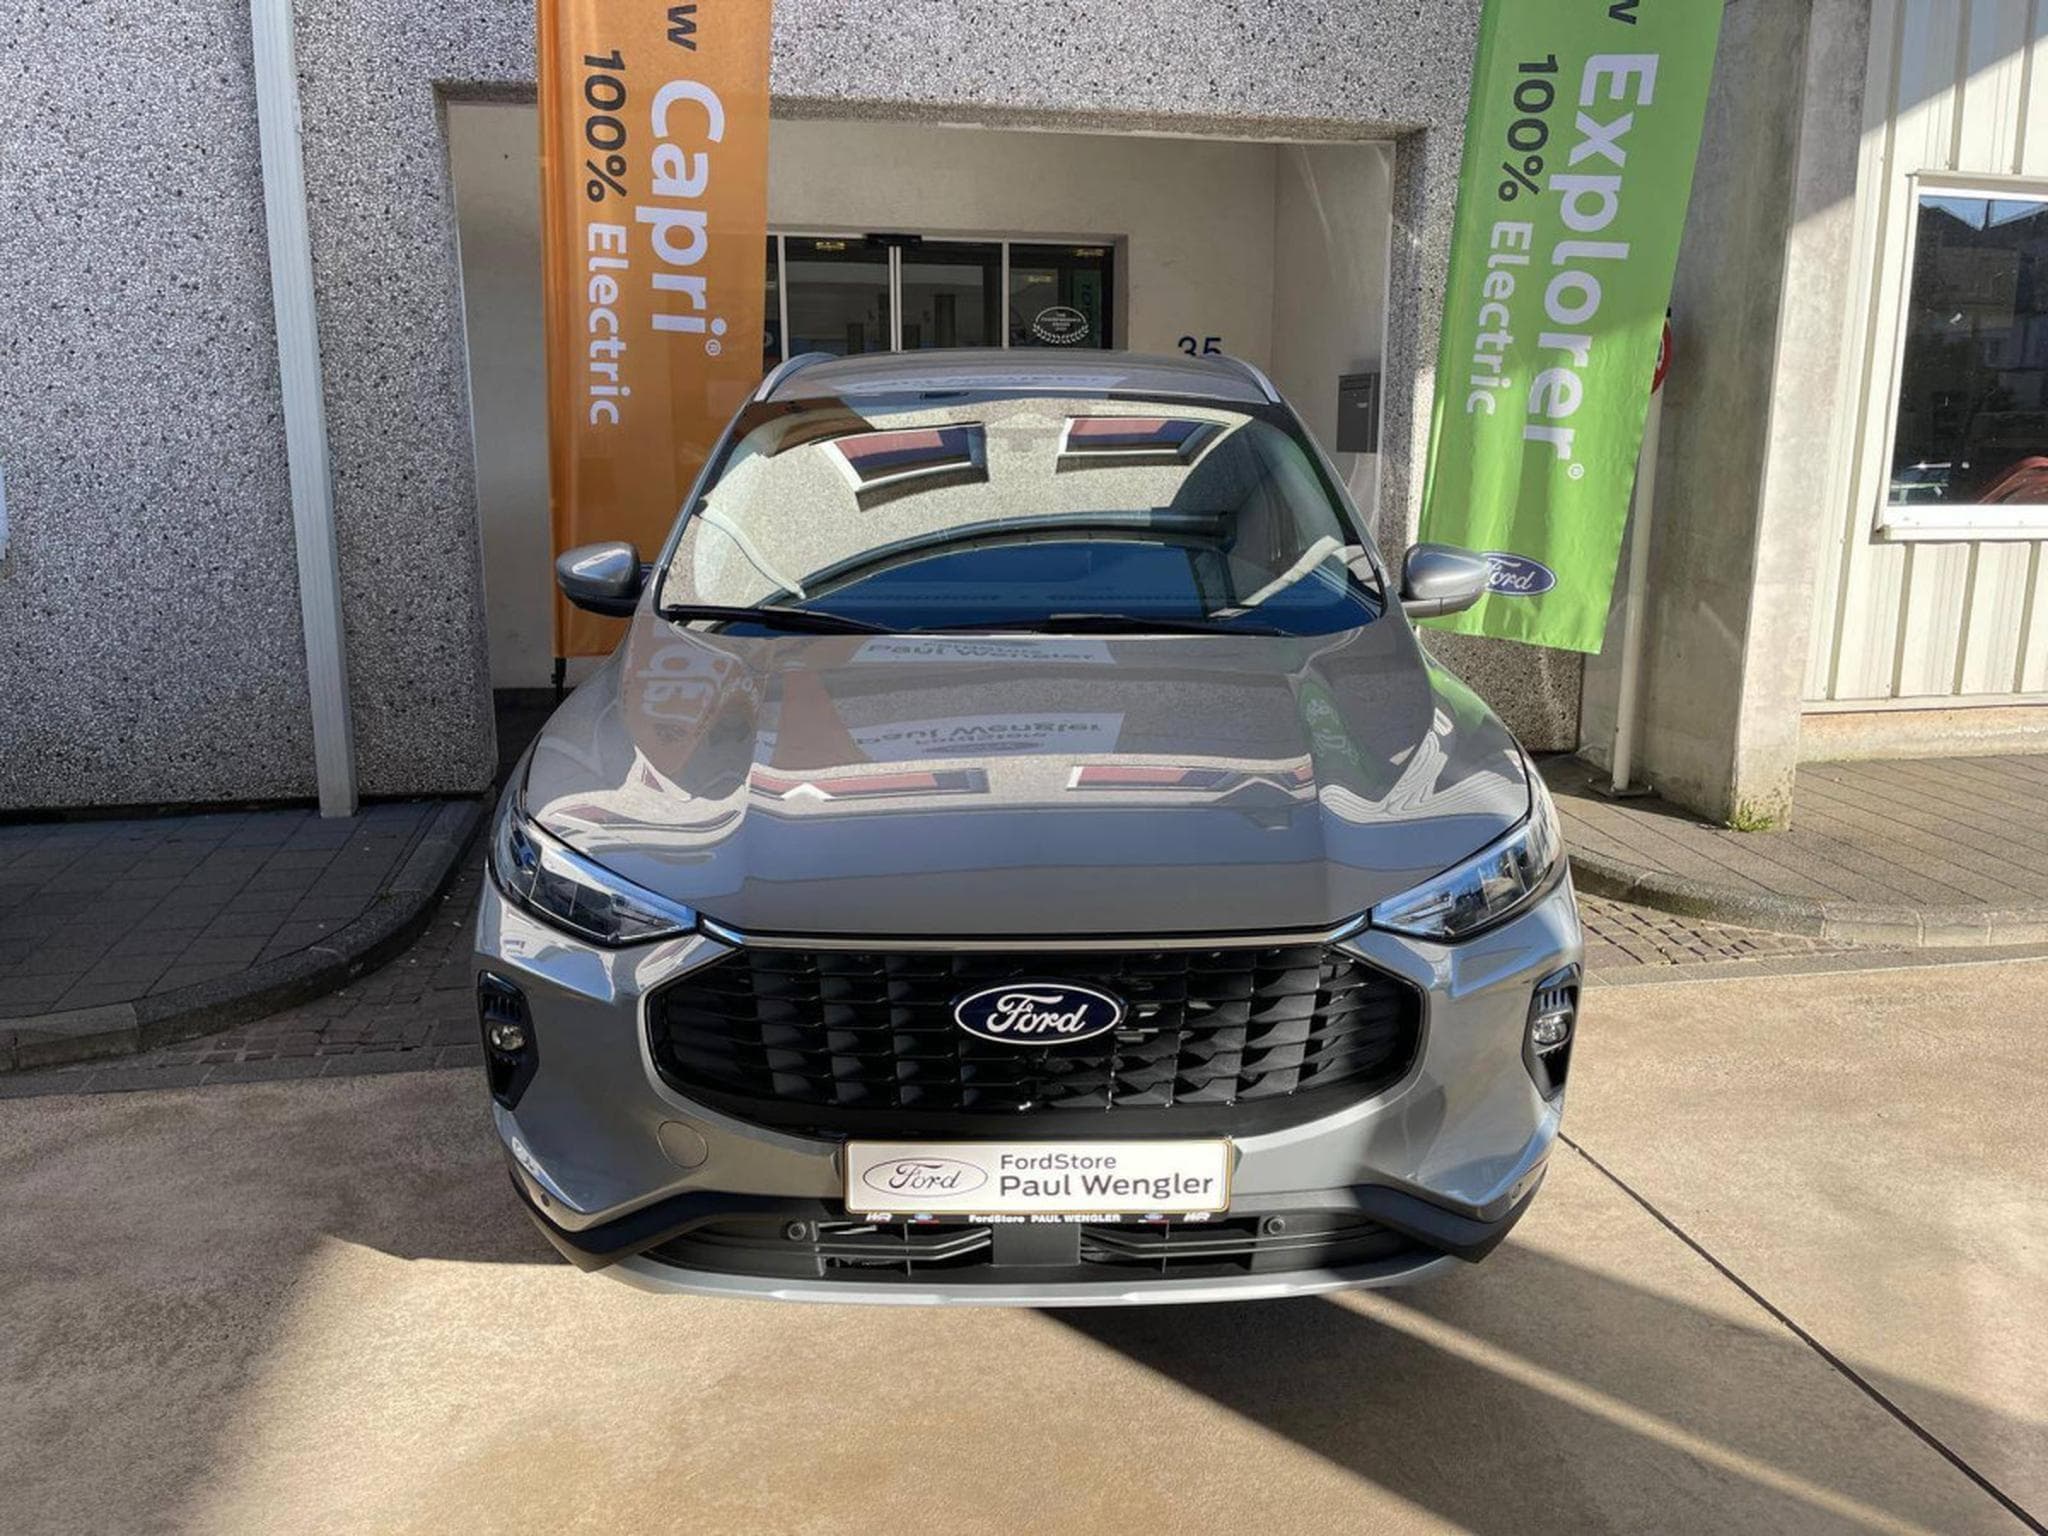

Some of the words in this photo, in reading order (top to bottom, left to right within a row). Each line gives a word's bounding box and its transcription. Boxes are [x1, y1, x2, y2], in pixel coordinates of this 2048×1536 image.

[667, 4, 697, 51] w
[583, 49, 628, 203] 100%
[1497, 54, 1559, 202] 100%
[587, 222, 631, 425] Electric
[1466, 220, 1534, 416] Electric
[986, 993, 1088, 1033] Ford
[888, 1162, 960, 1190] Ford
[1001, 1154, 1117, 1170] FordStore
[1000, 1175, 1071, 1196] Paul
[1082, 1174, 1213, 1199] Wengler
[968, 1214, 1025, 1223] FordStore
[1031, 1214, 1061, 1223] PAUL
[1064, 1214, 1121, 1223] WENGLER
